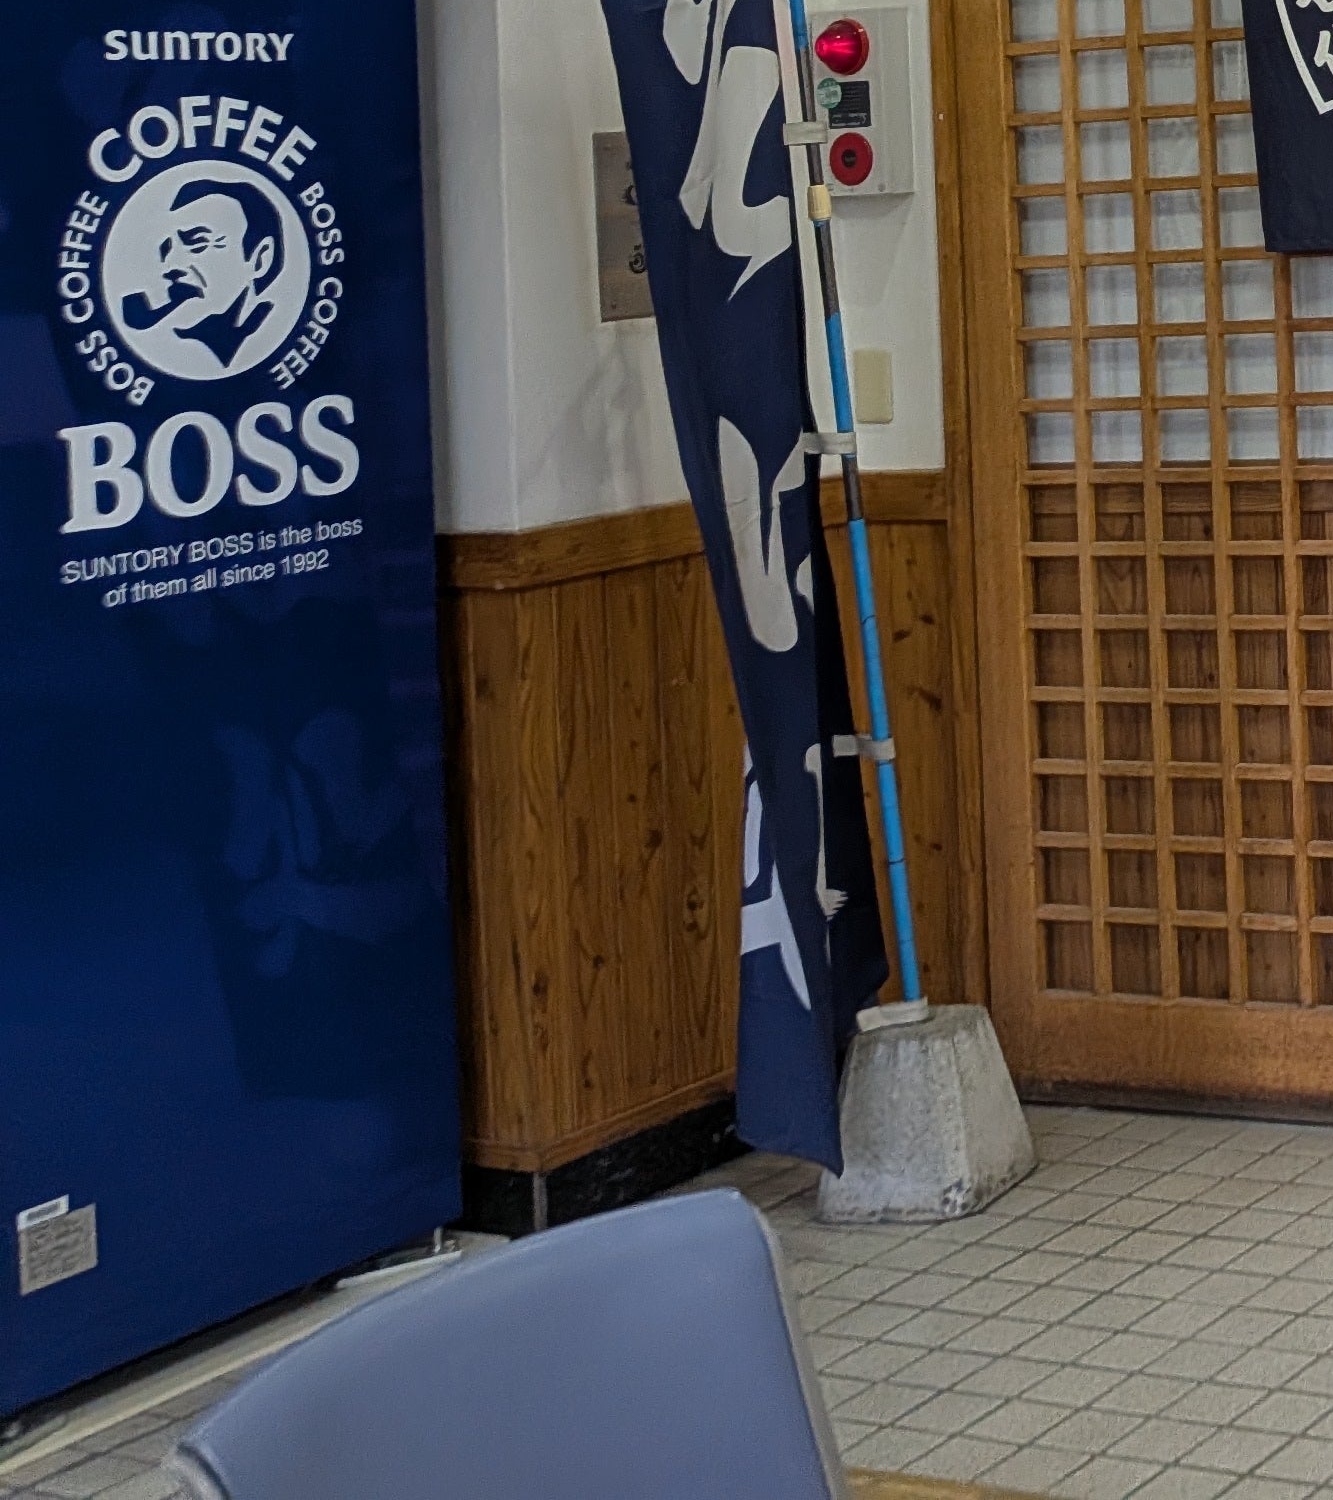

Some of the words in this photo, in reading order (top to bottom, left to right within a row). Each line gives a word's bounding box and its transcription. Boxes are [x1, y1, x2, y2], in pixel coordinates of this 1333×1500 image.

[103, 29, 294, 61] SUNTORY
[88, 95, 317, 182] COFFEE
[58, 190, 109, 323] COFFEE
[300, 181, 344, 266] BOSS
[76, 329, 155, 406] BOSS
[269, 277, 343, 390] COFFEE
[58, 395, 361, 534] BOSS
[60, 543, 185, 585] SUNTORY
[187, 532, 254, 563] BOSS
[258, 530, 277, 550] is
[280, 525, 312, 546] the
[315, 518, 363, 542] boss
[102, 584, 128, 609] of
[131, 576, 187, 603] them
[190, 568, 217, 591] all
[220, 561, 276, 587] since
[280, 549, 330, 575] 1992
